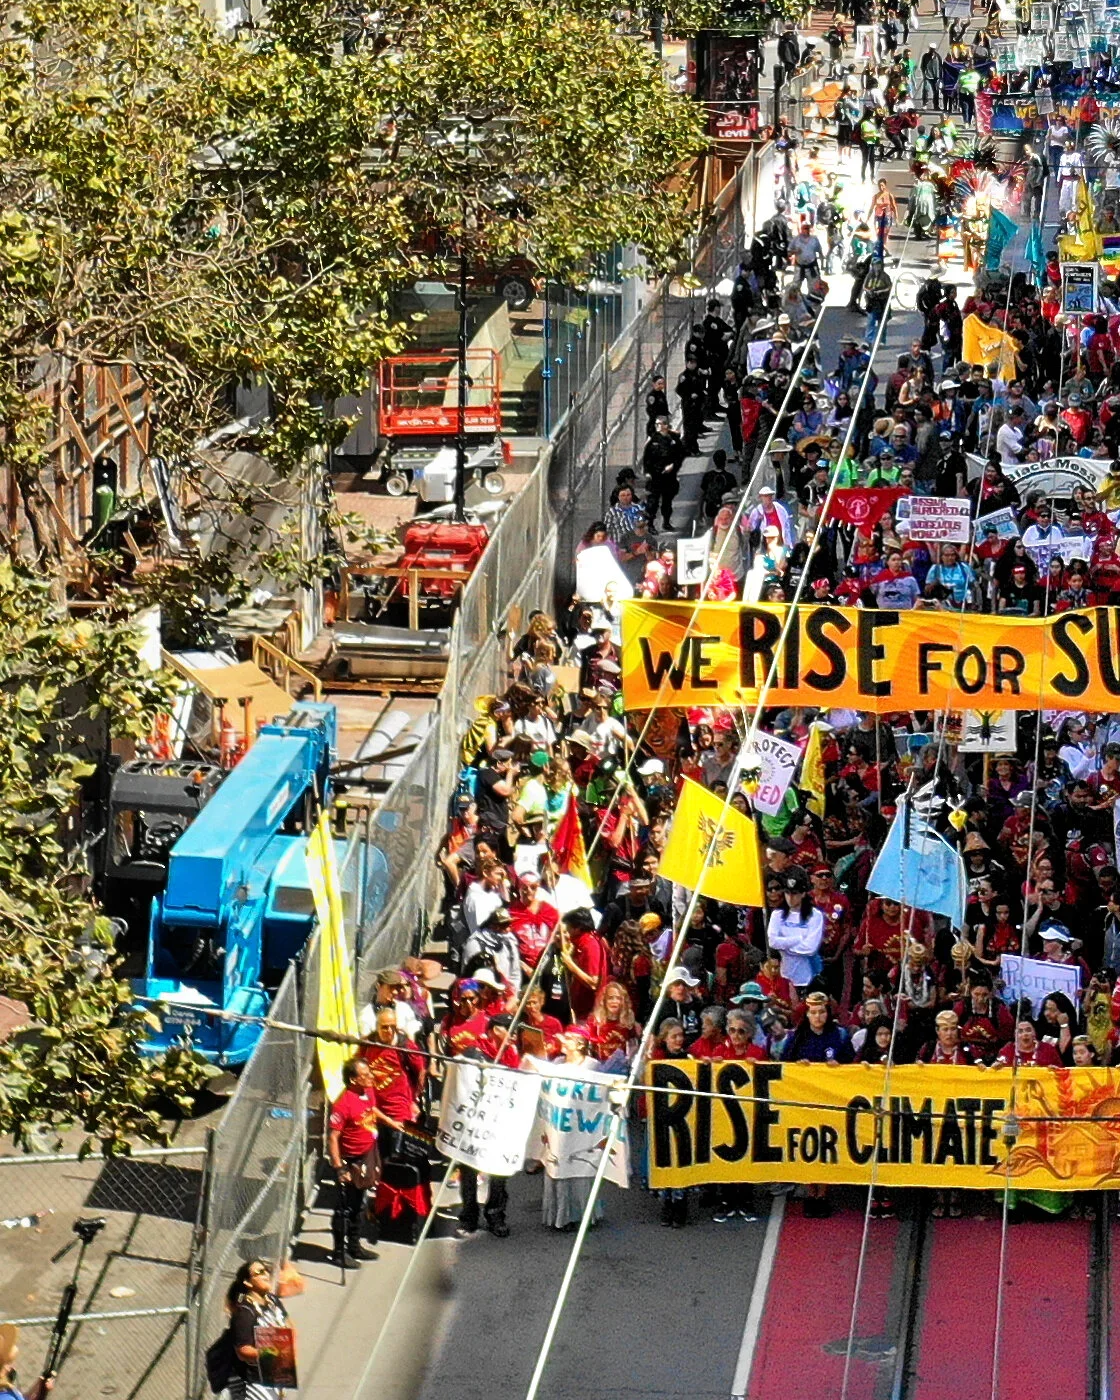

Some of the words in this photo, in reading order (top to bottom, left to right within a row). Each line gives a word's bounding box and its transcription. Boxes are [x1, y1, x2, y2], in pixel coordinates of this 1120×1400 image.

[640, 636, 720, 691] WE
[739, 605, 900, 697] RISE
[918, 642, 1025, 696] FOR
[753, 739, 796, 768] ROTECT
[1003, 961, 1075, 993] PROTECT
[651, 1062, 784, 1168] RISE
[787, 1126, 838, 1164] FOR
[845, 1094, 1005, 1166] CLIMATE
